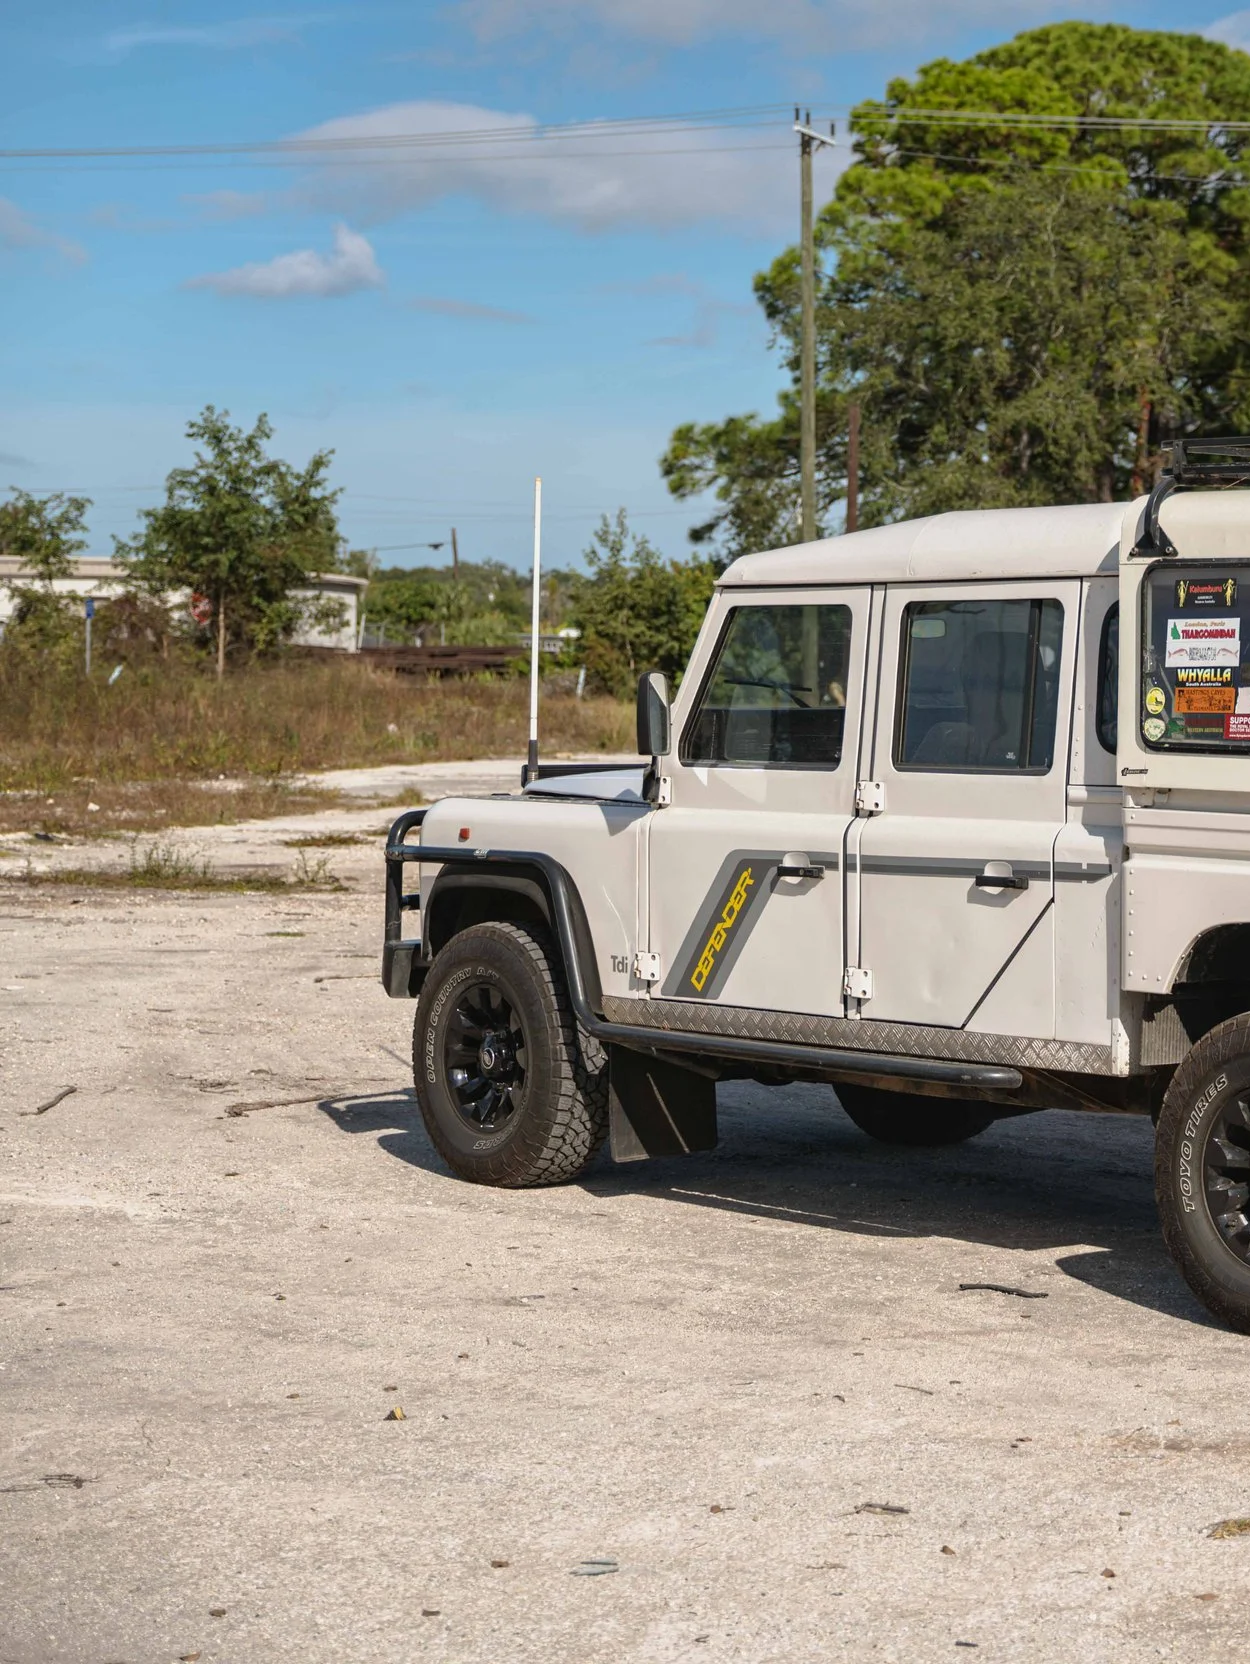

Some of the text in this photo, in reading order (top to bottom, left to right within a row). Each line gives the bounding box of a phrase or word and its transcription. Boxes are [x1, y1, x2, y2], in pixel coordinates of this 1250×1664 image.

[1177, 668, 1231, 682] WHYALLA
[610, 955, 628, 974] Tdi
[690, 867, 755, 992] DEFENDER
[426, 966, 500, 1084] OPEN COUNTRY A/T
[1180, 1073, 1228, 1213] TOYO TIRES
